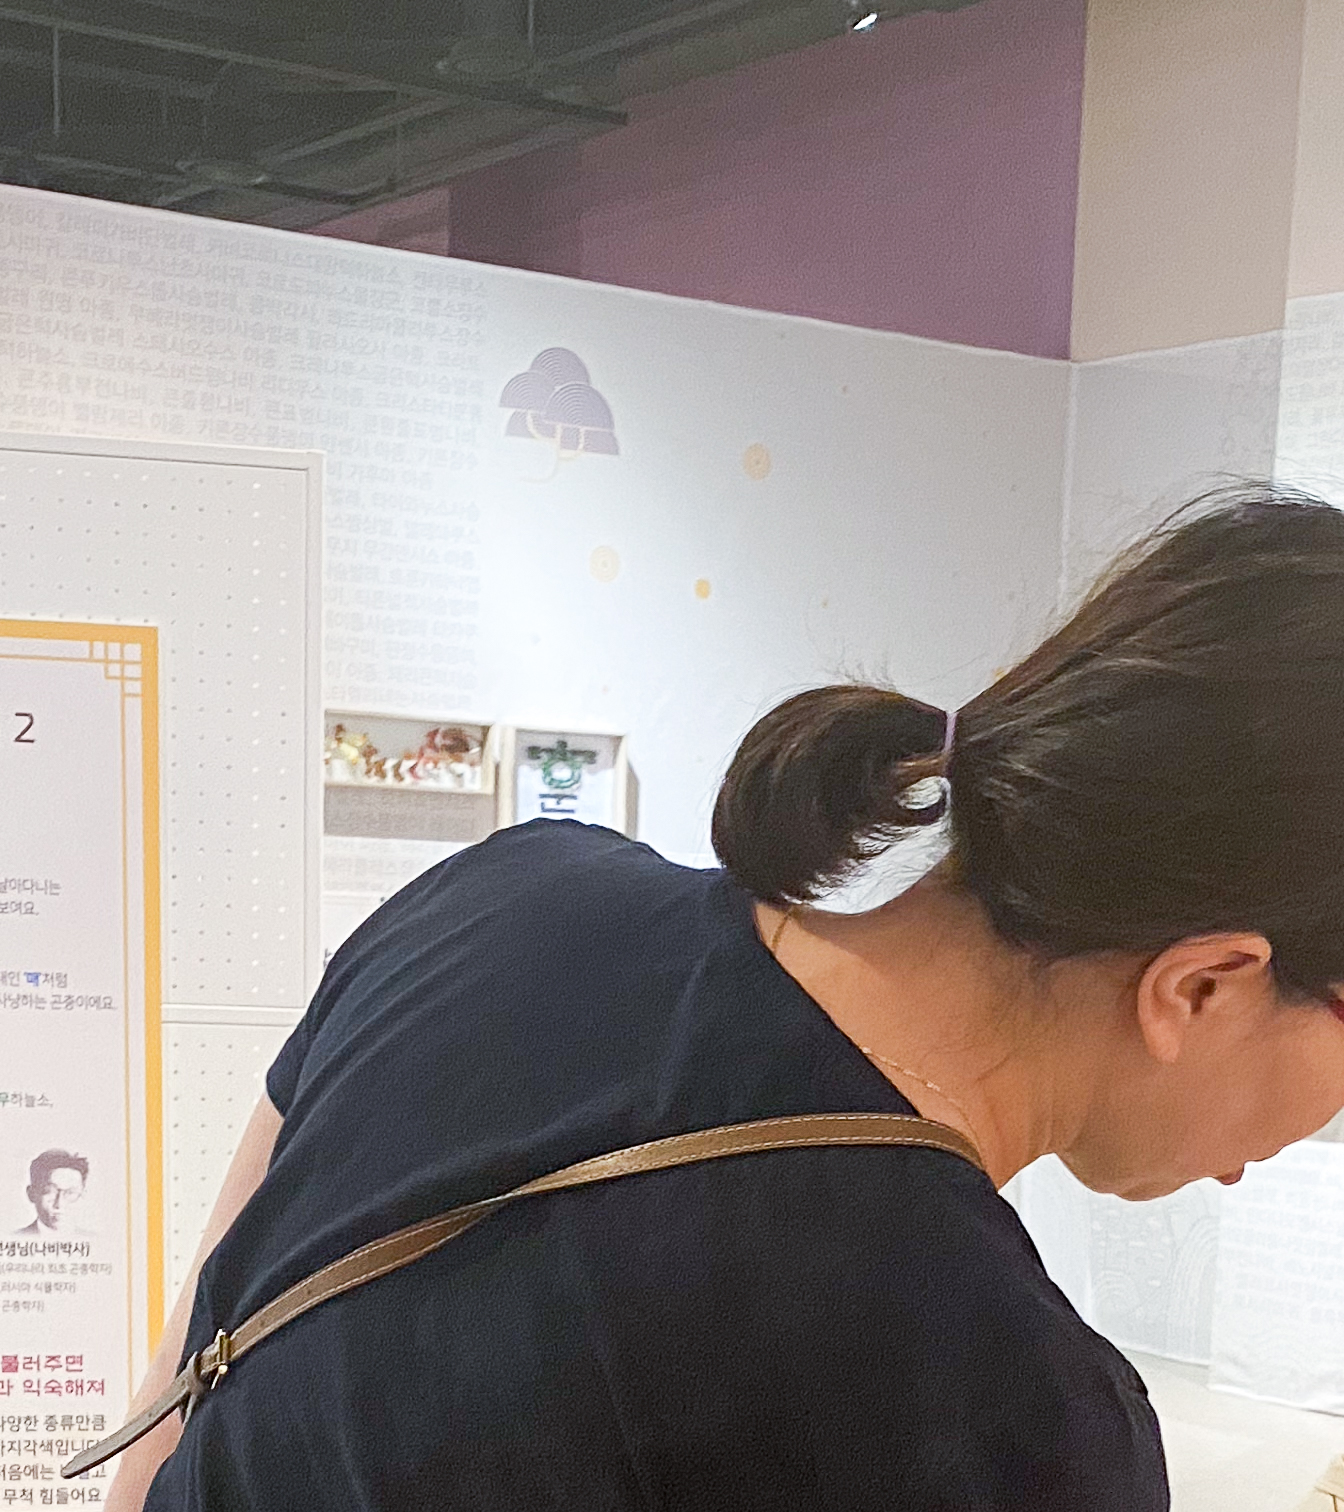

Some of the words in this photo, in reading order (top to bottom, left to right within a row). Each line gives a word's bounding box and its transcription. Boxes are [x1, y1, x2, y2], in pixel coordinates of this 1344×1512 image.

[14, 712, 36, 743] 2
[0, 1353, 84, 1373] 불러주면
[23, 1377, 106, 1398] 익숙해져
[44, 1413, 107, 1433] 종류만큼
[3, 1488, 34, 1506] 무척
